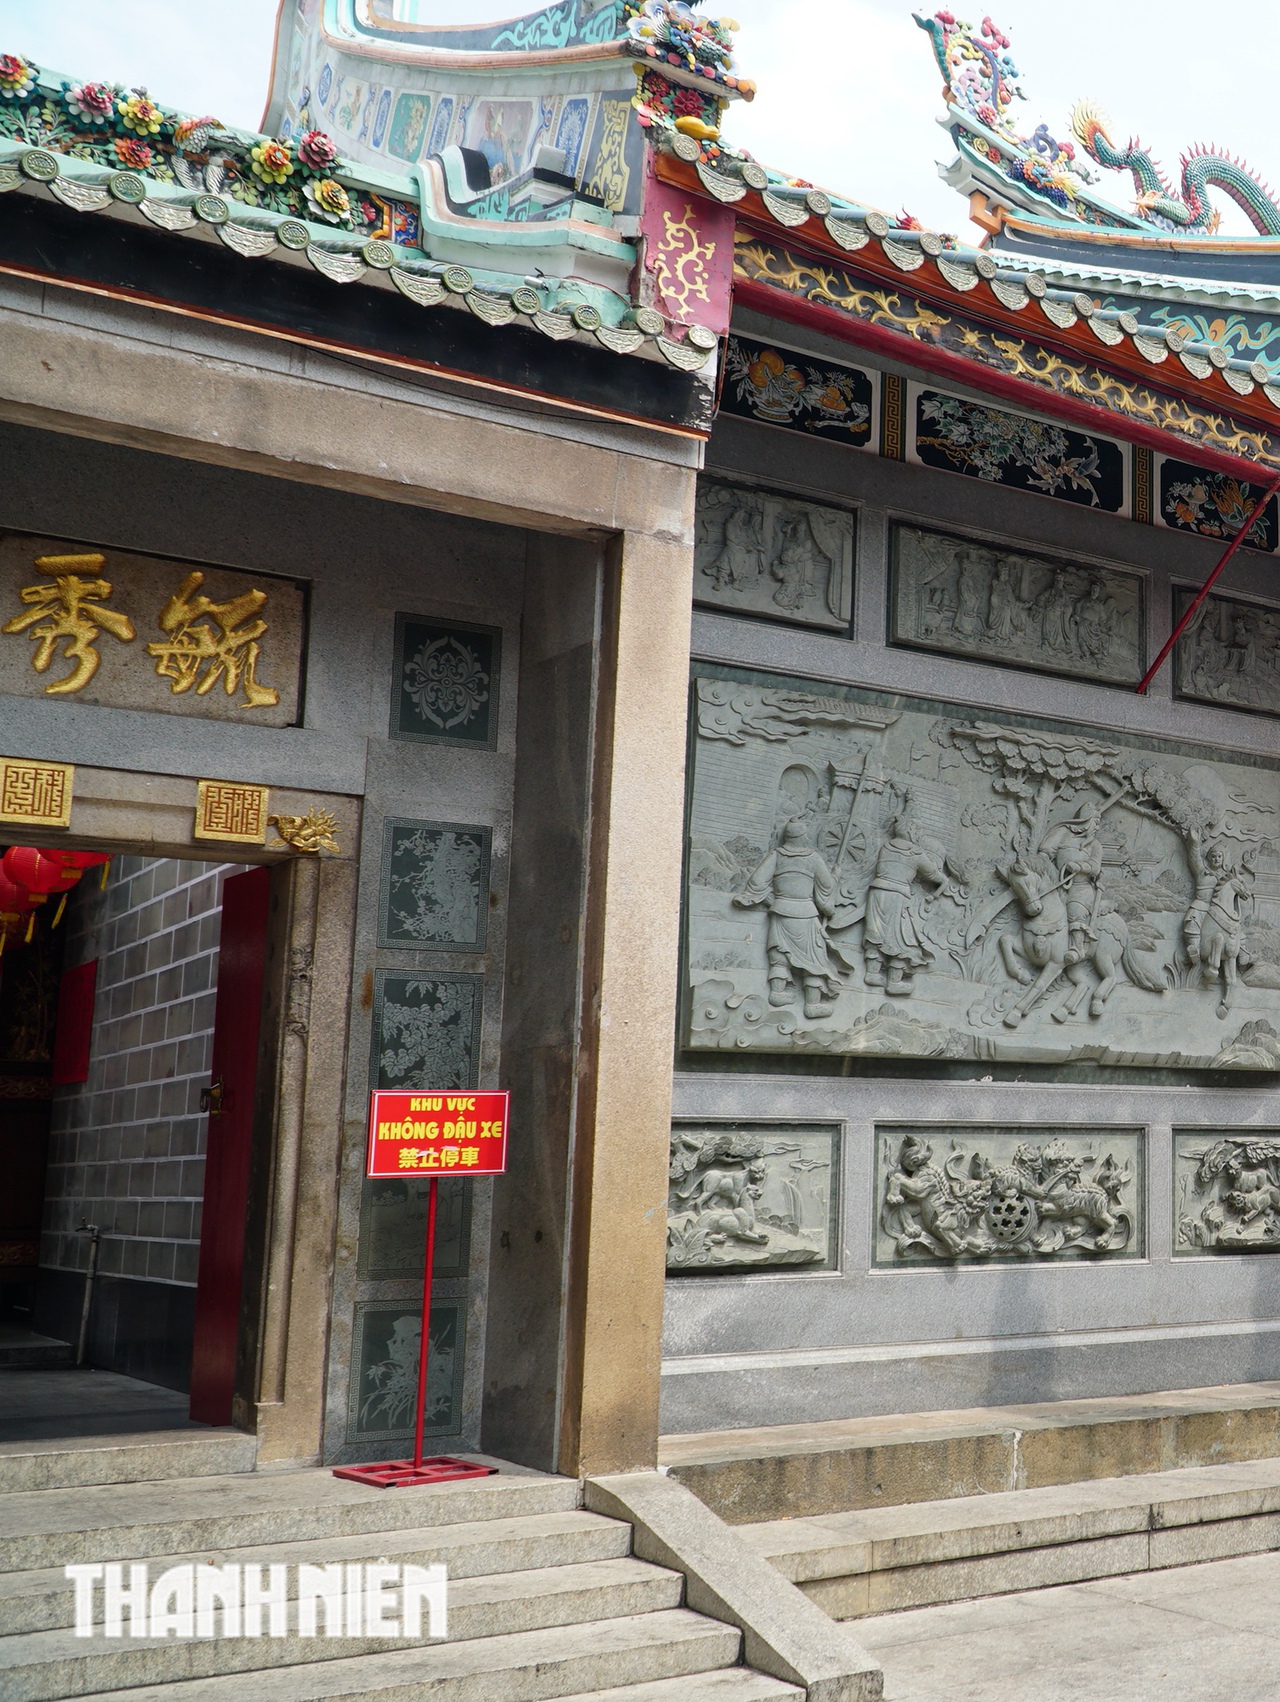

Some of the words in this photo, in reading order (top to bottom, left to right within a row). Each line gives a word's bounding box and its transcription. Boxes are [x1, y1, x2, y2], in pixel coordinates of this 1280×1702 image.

[411, 1098, 442, 1111] KHU
[446, 1098, 475, 1114] VỰC
[378, 1116, 439, 1140] KHÔNG
[443, 1116, 476, 1143] ĐẬU
[480, 1121, 503, 1138] XE
[398, 1146, 480, 1168] 禁止停車
